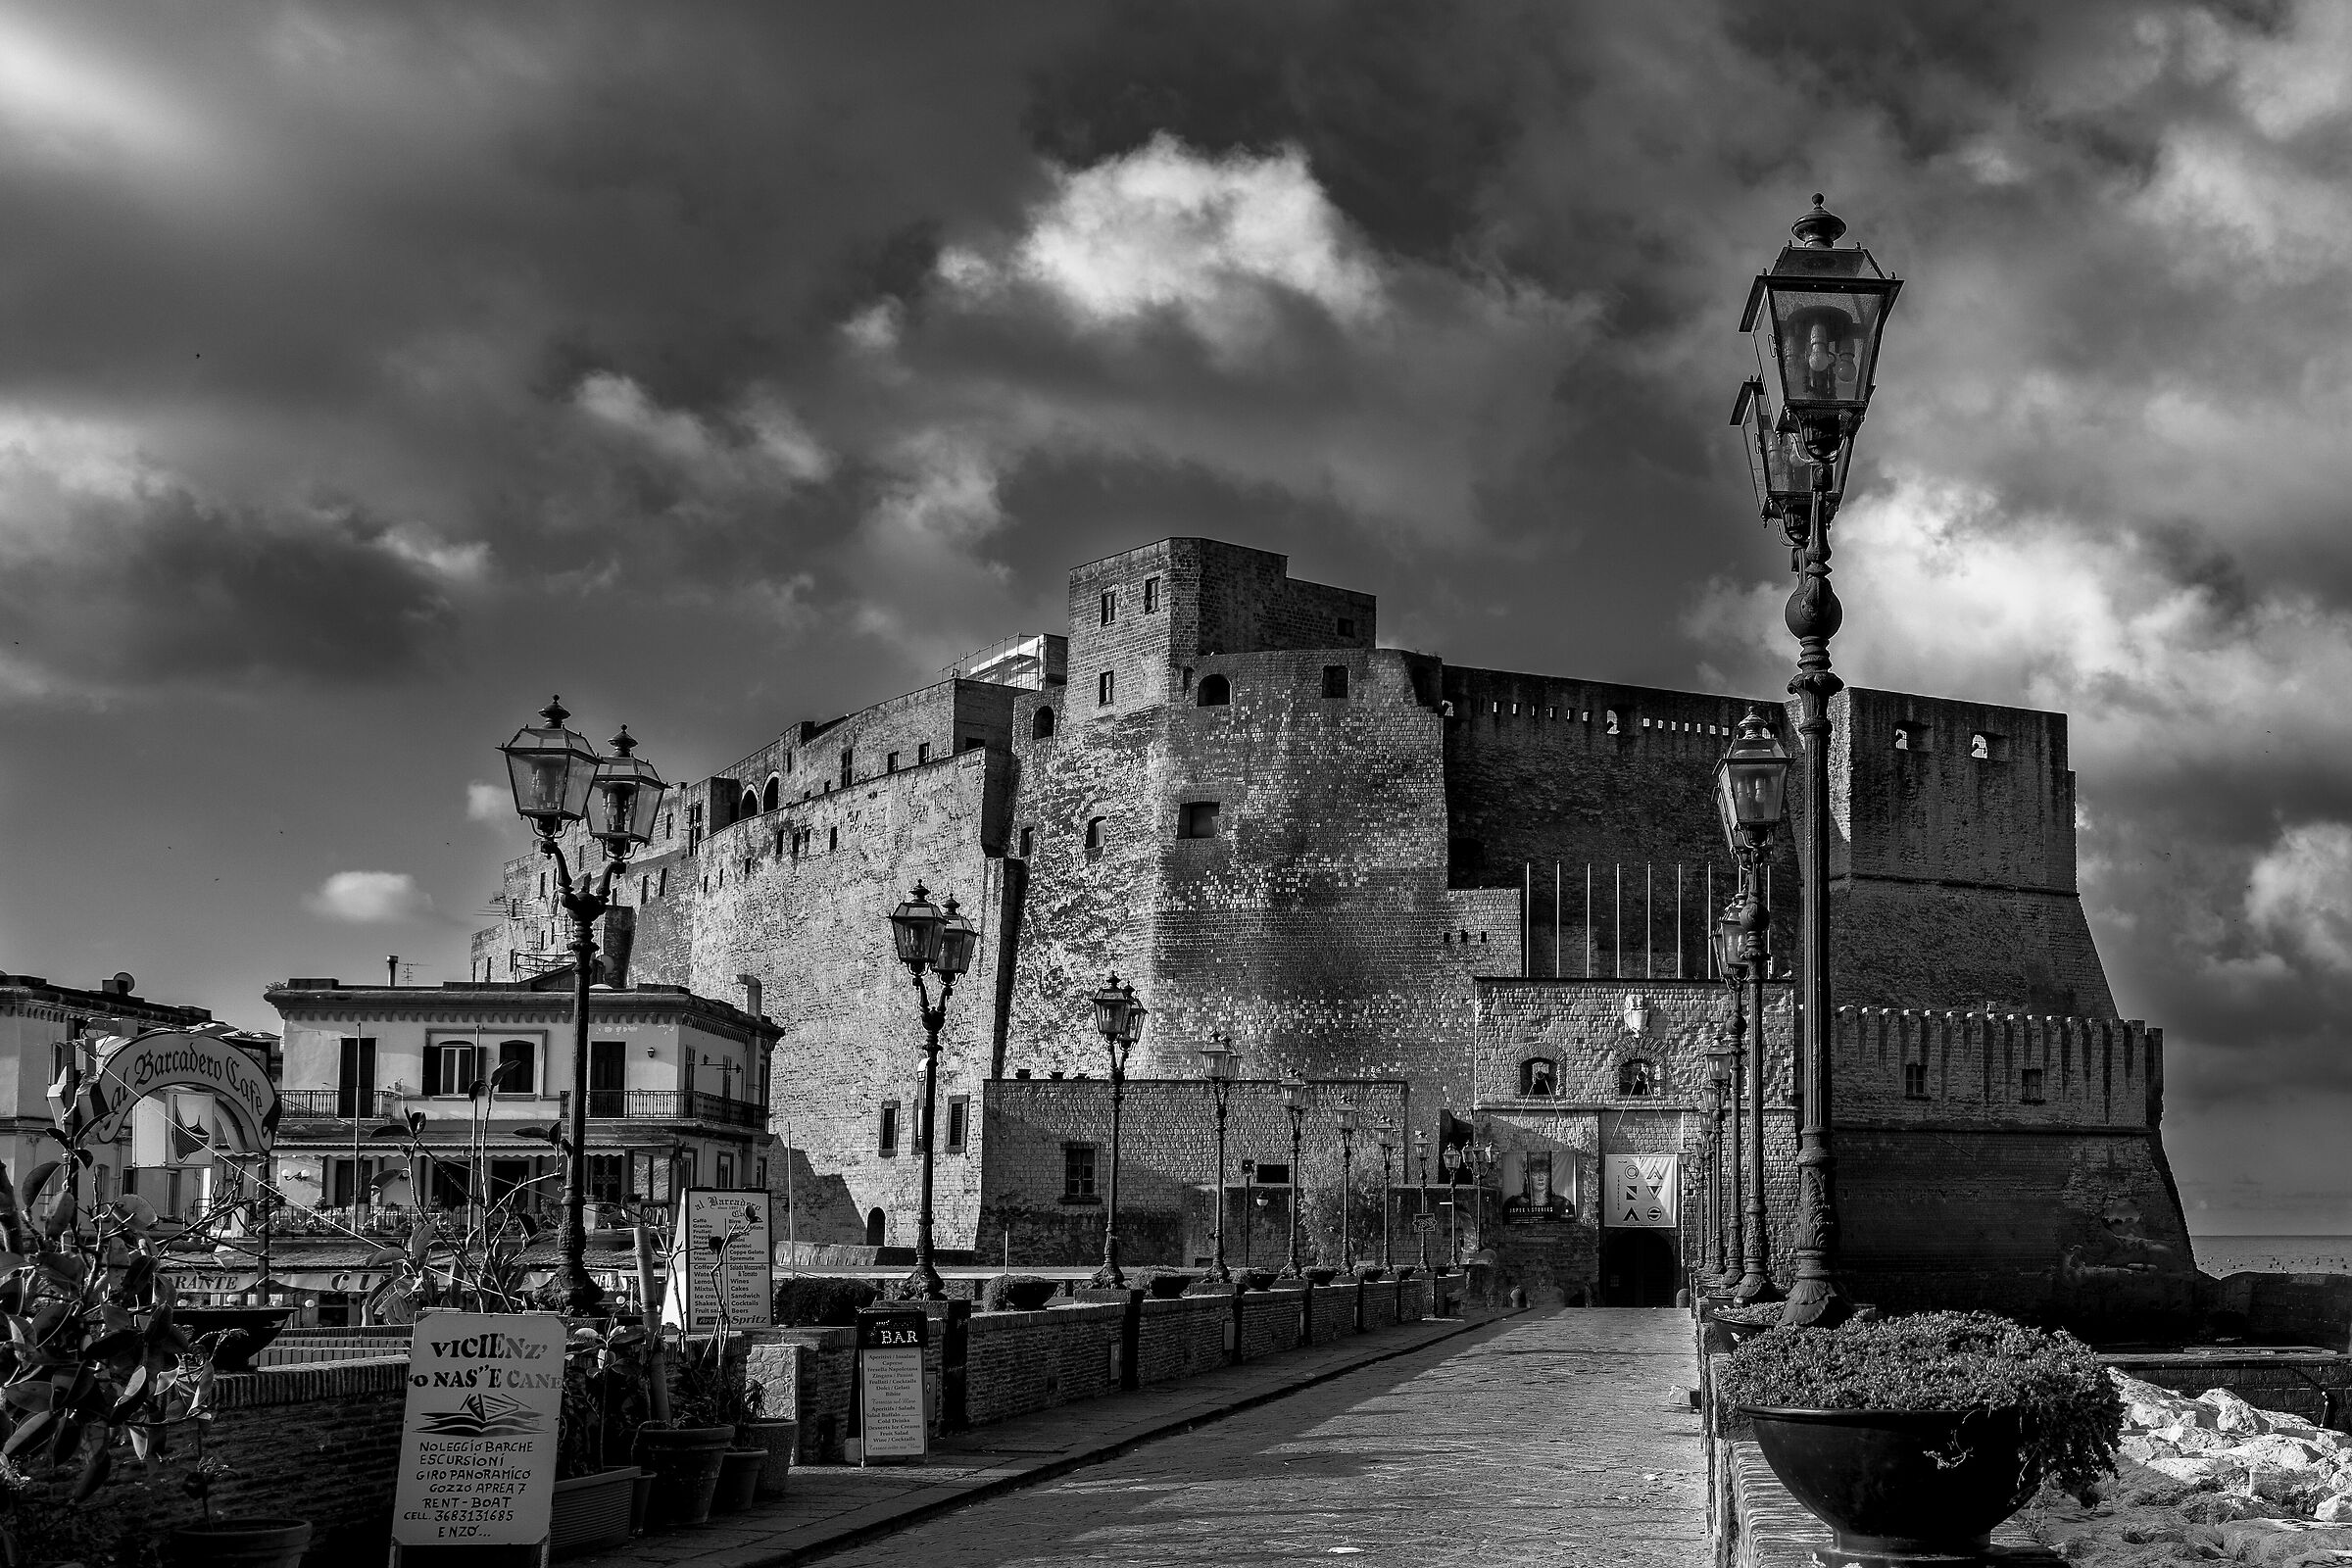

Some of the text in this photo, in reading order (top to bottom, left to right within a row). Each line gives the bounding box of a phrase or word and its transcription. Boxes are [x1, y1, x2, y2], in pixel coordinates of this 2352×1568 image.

[111, 1066, 129, 1110] al
[134, 1042, 222, 1089] Barcadero
[731, 1315, 767, 1325] Spritz
[881, 1330, 918, 1344] BAR
[507, 1370, 563, 1390] CANE
[485, 1442, 534, 1452] BARCHE
[416, 1470, 447, 1481] GIRO
[429, 1483, 527, 1494] GOZZO APREA 7
[403, 1510, 514, 1522] CELL. 3683131685
